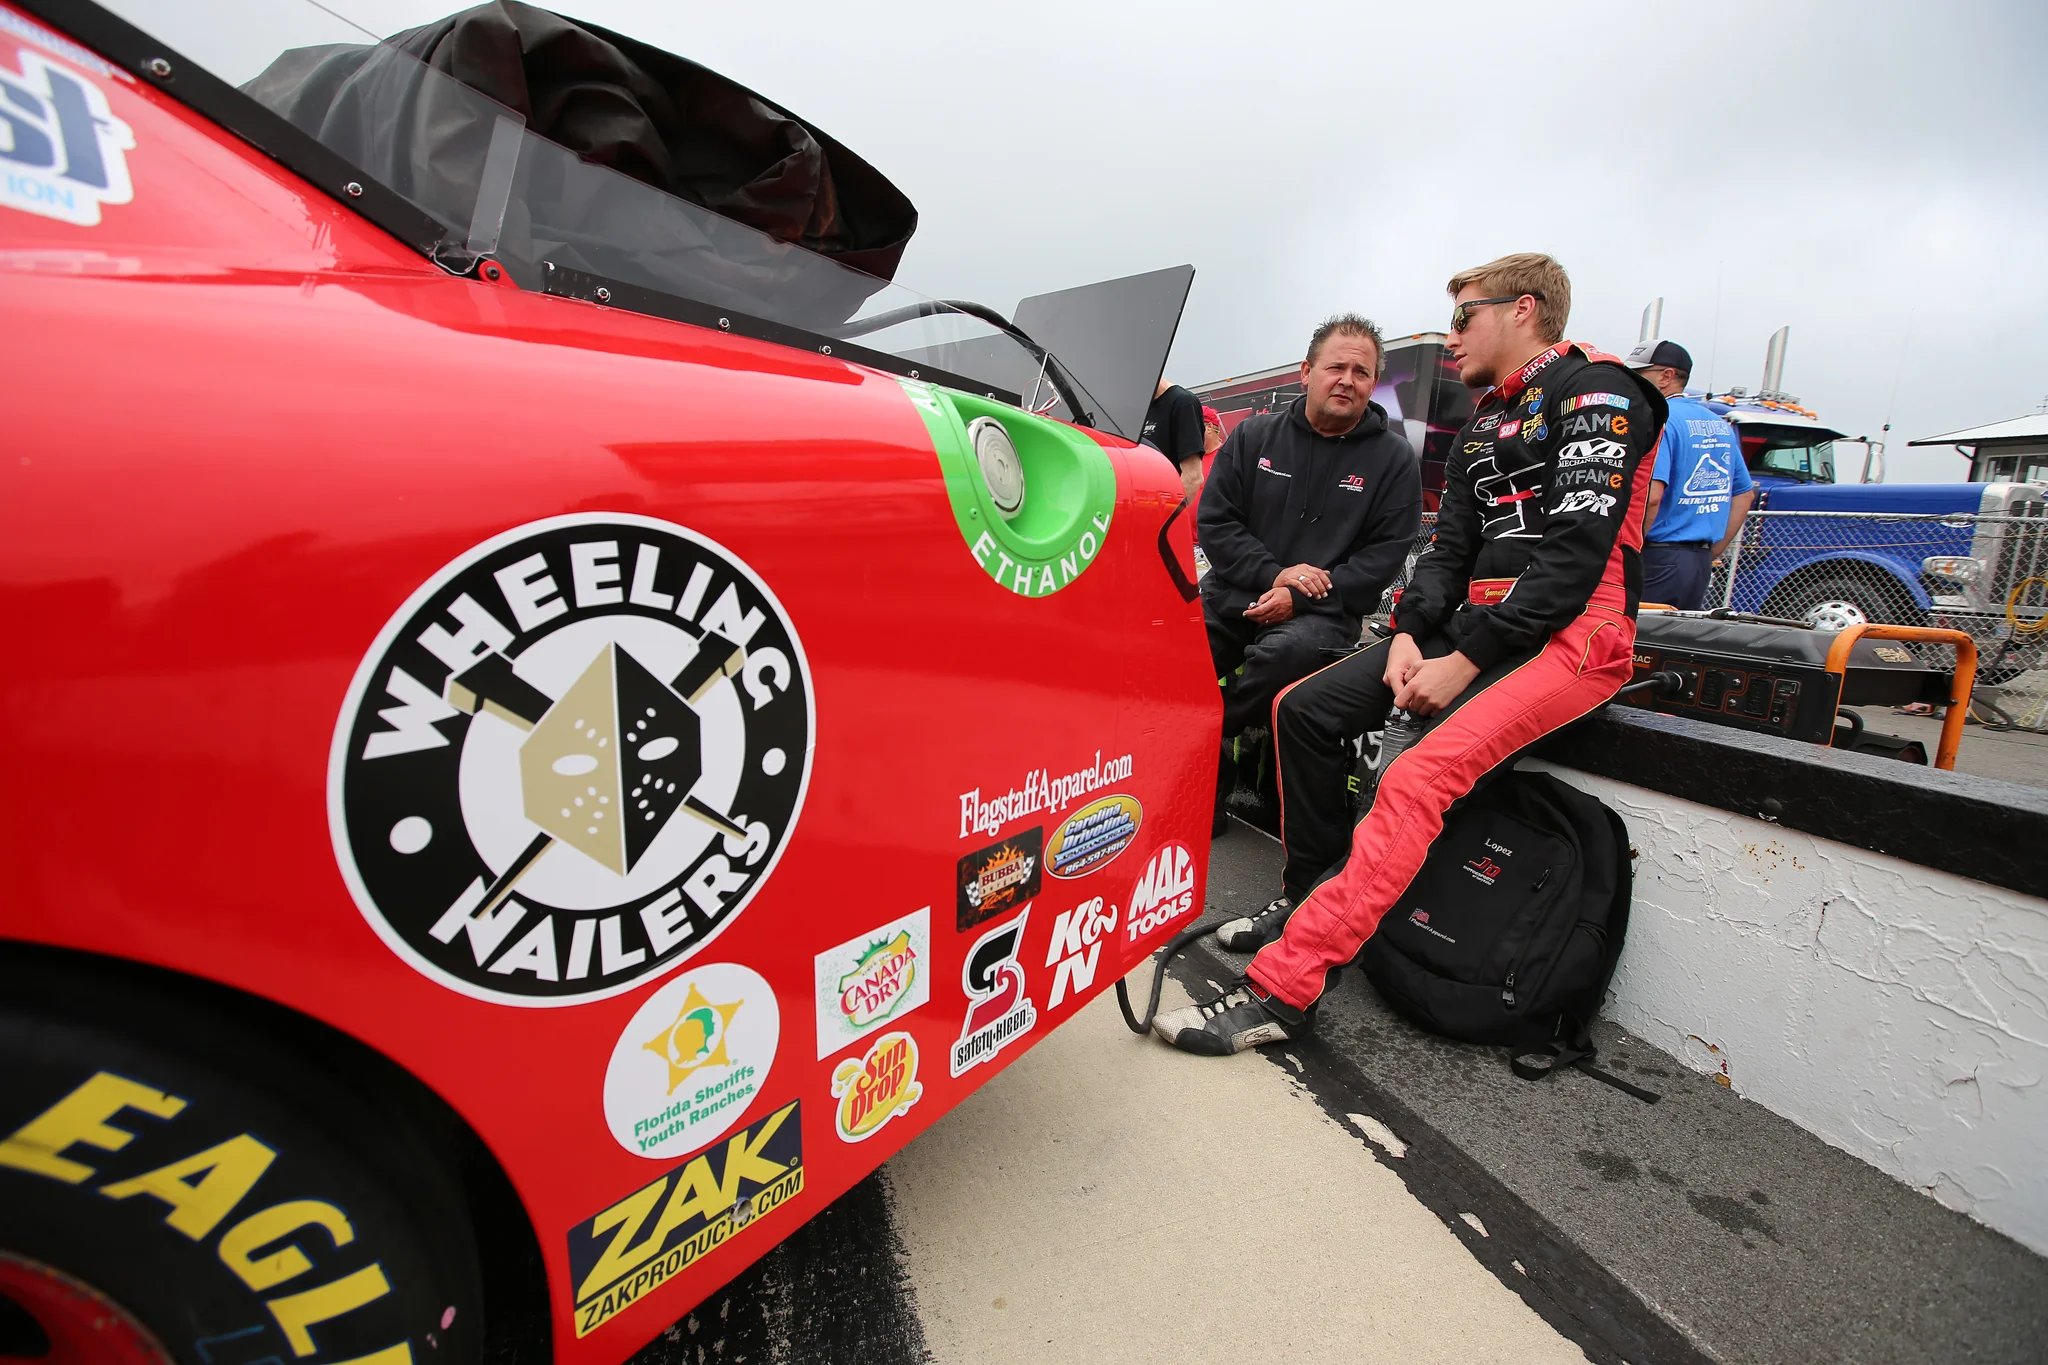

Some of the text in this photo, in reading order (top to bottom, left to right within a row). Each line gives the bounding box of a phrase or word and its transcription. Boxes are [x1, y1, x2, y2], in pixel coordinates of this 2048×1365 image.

[1581, 393, 1627, 409] NASCAR
[1557, 458, 1623, 468] MECHANIX WEAR
[1549, 490, 1617, 516] JDR
[1562, 494, 1608, 505] GRAPHICS
[971, 512, 1111, 595] ETHANOL
[362, 539, 792, 760] WHEELING
[959, 749, 1133, 839] FlagstaffApparel.com
[1064, 803, 1121, 836] Carolina
[1061, 811, 1131, 851] Driveline
[1484, 838, 1513, 857] Lopez
[428, 814, 771, 982] NAILERS
[981, 861, 1020, 887] BUBBA
[1128, 845, 1194, 921] MAC
[1127, 891, 1193, 942] TOOLS
[841, 946, 916, 1016] CANADA
[865, 972, 900, 1014] DRY
[856, 1038, 907, 1090] Sun
[634, 1066, 755, 1137] Florida Sheriffs
[637, 1083, 754, 1152] Youth Ranches
[849, 1062, 906, 1132] Drop
[0, 1071, 415, 1365] EAGL
[576, 1101, 799, 1305] ZAK
